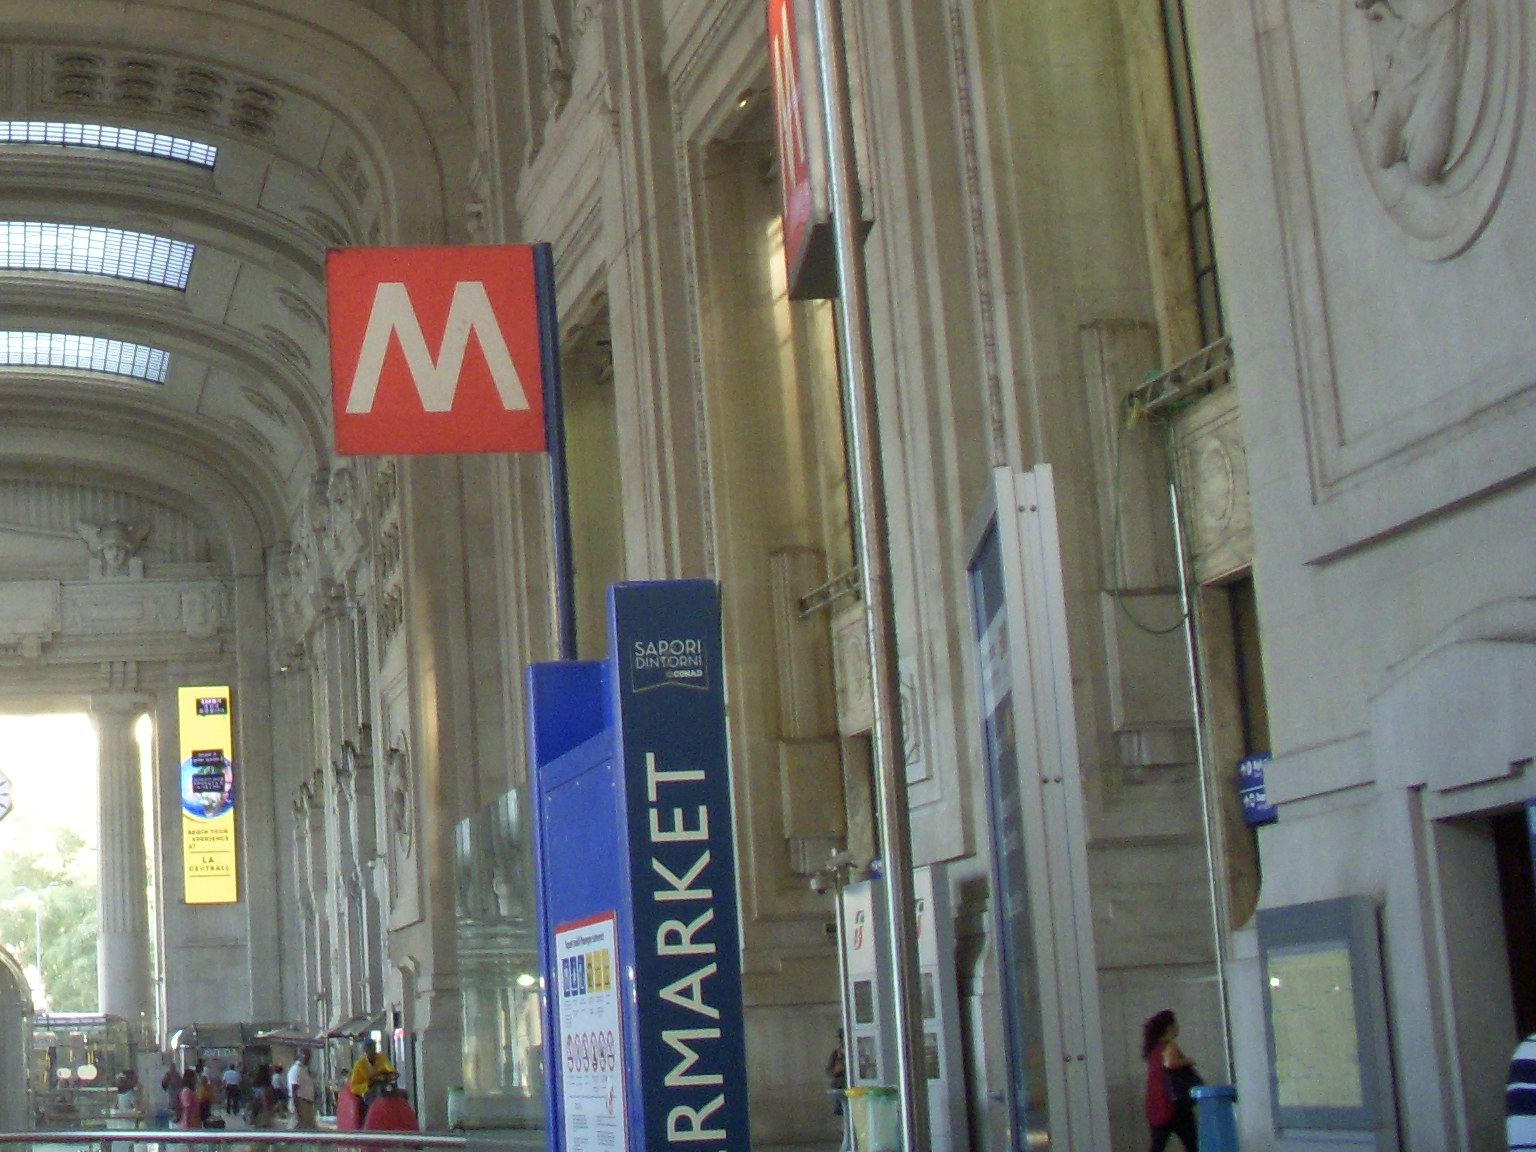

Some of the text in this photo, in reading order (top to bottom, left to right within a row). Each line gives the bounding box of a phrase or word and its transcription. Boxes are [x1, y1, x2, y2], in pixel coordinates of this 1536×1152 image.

[345, 281, 530, 415] M
[634, 639, 701, 656] SAPORI
[635, 654, 703, 669] DINTORNI
[645, 751, 728, 1152] RMARKET
